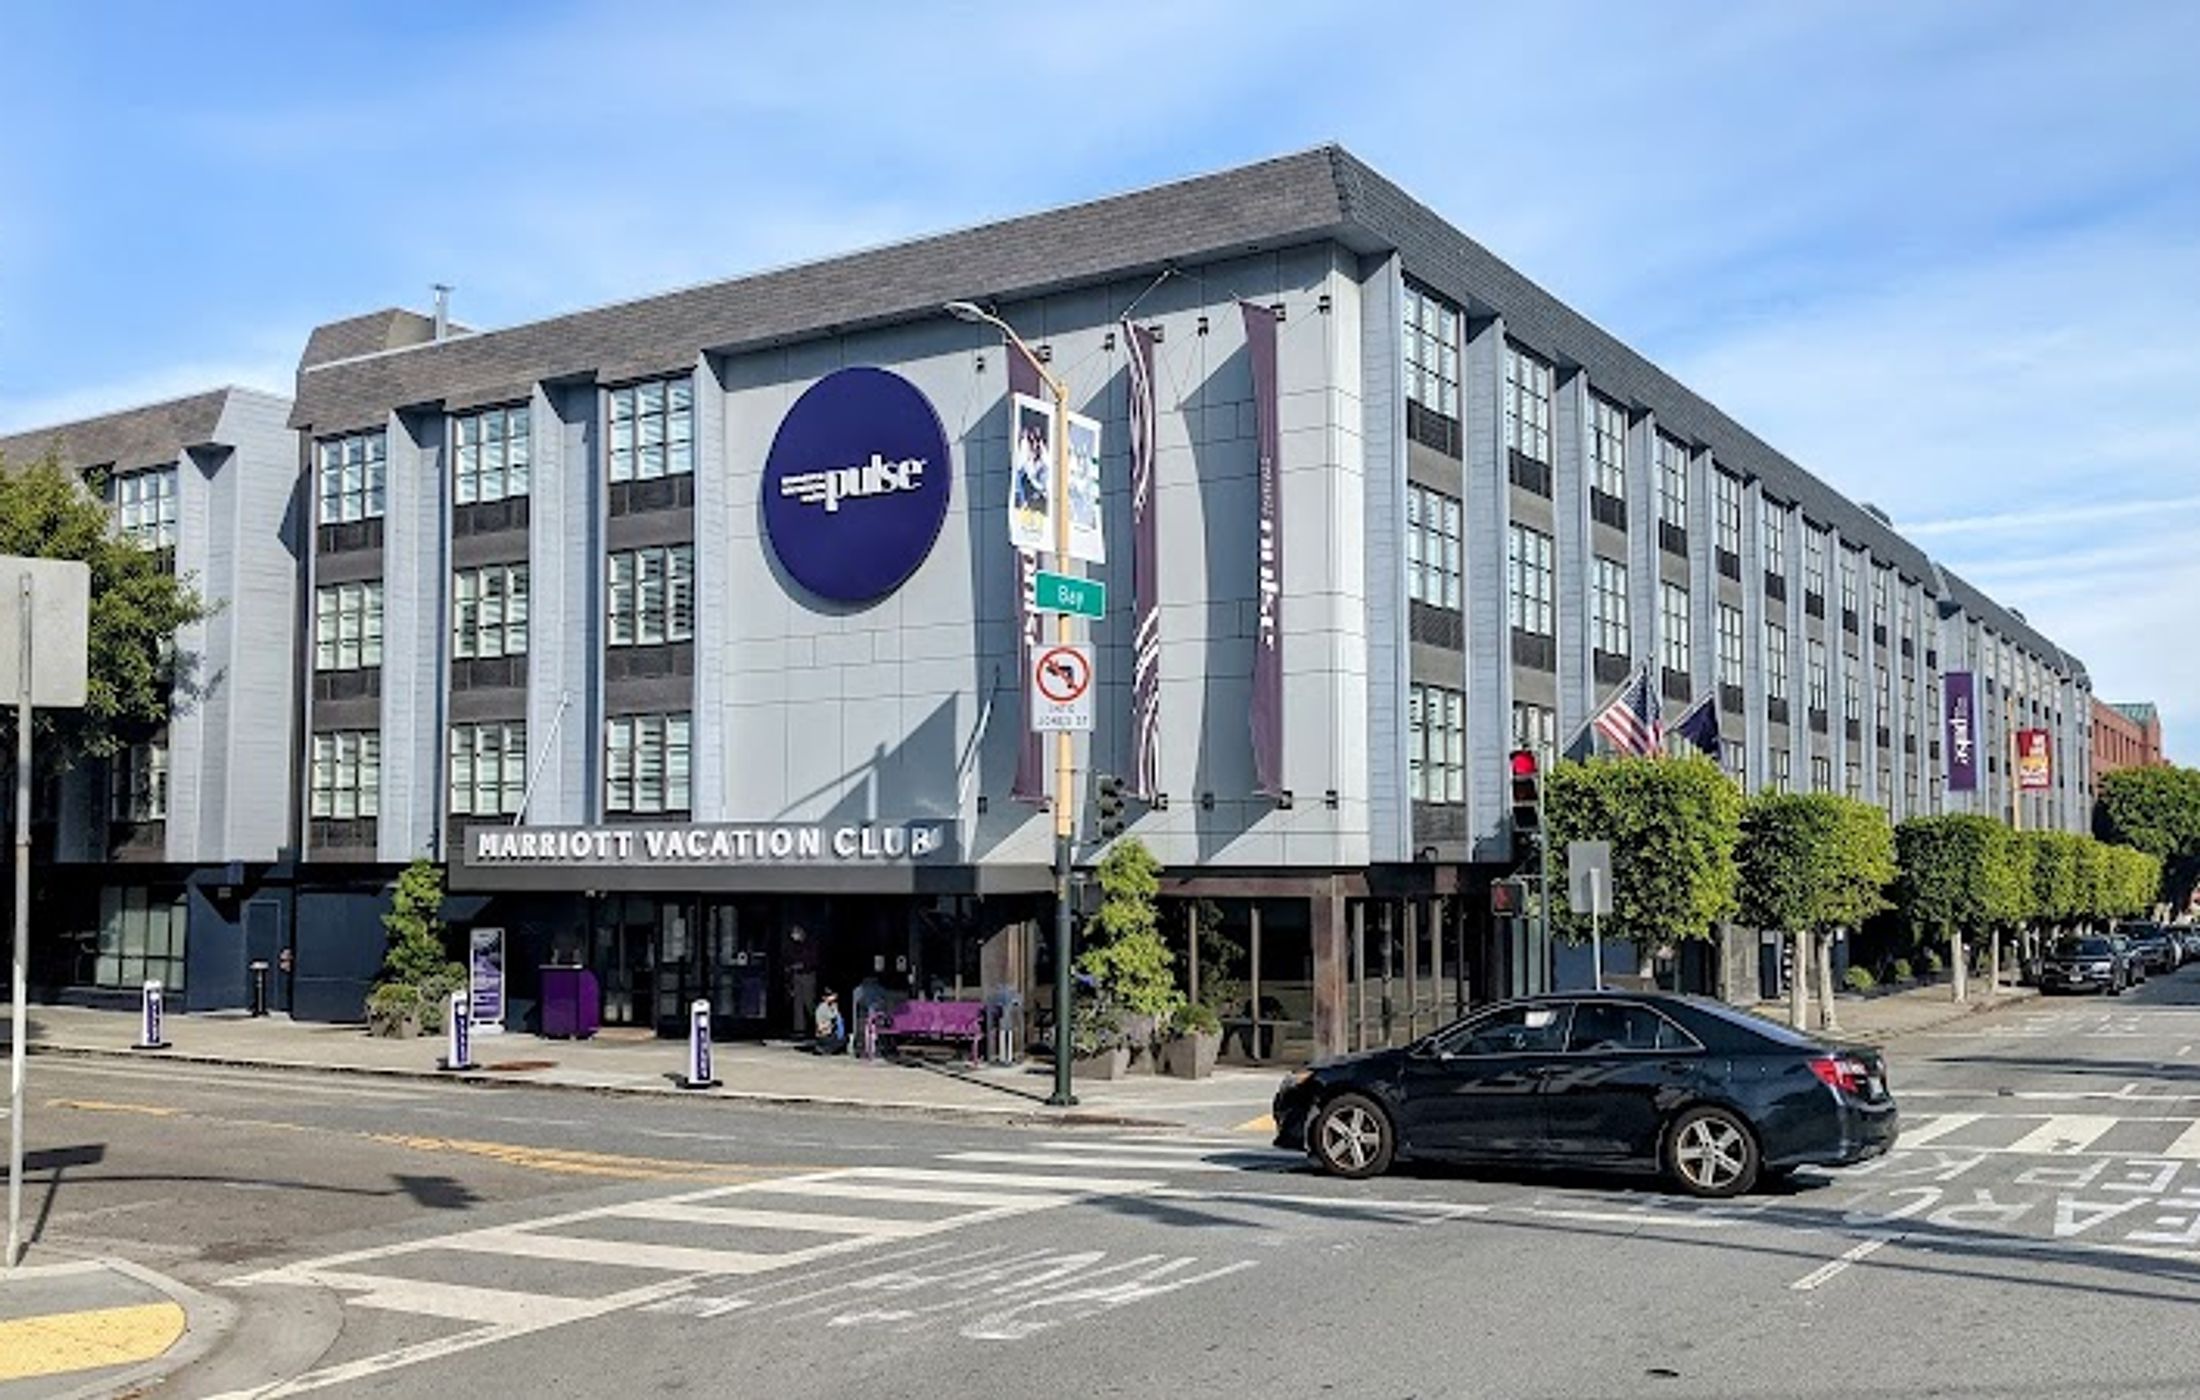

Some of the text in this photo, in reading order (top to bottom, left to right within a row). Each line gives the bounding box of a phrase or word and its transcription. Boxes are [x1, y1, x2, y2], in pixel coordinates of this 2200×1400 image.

[823, 453, 924, 513] pulse
[1057, 584, 1085, 611] Bay
[478, 826, 938, 858] MARRIOTT VACATION CLUB
